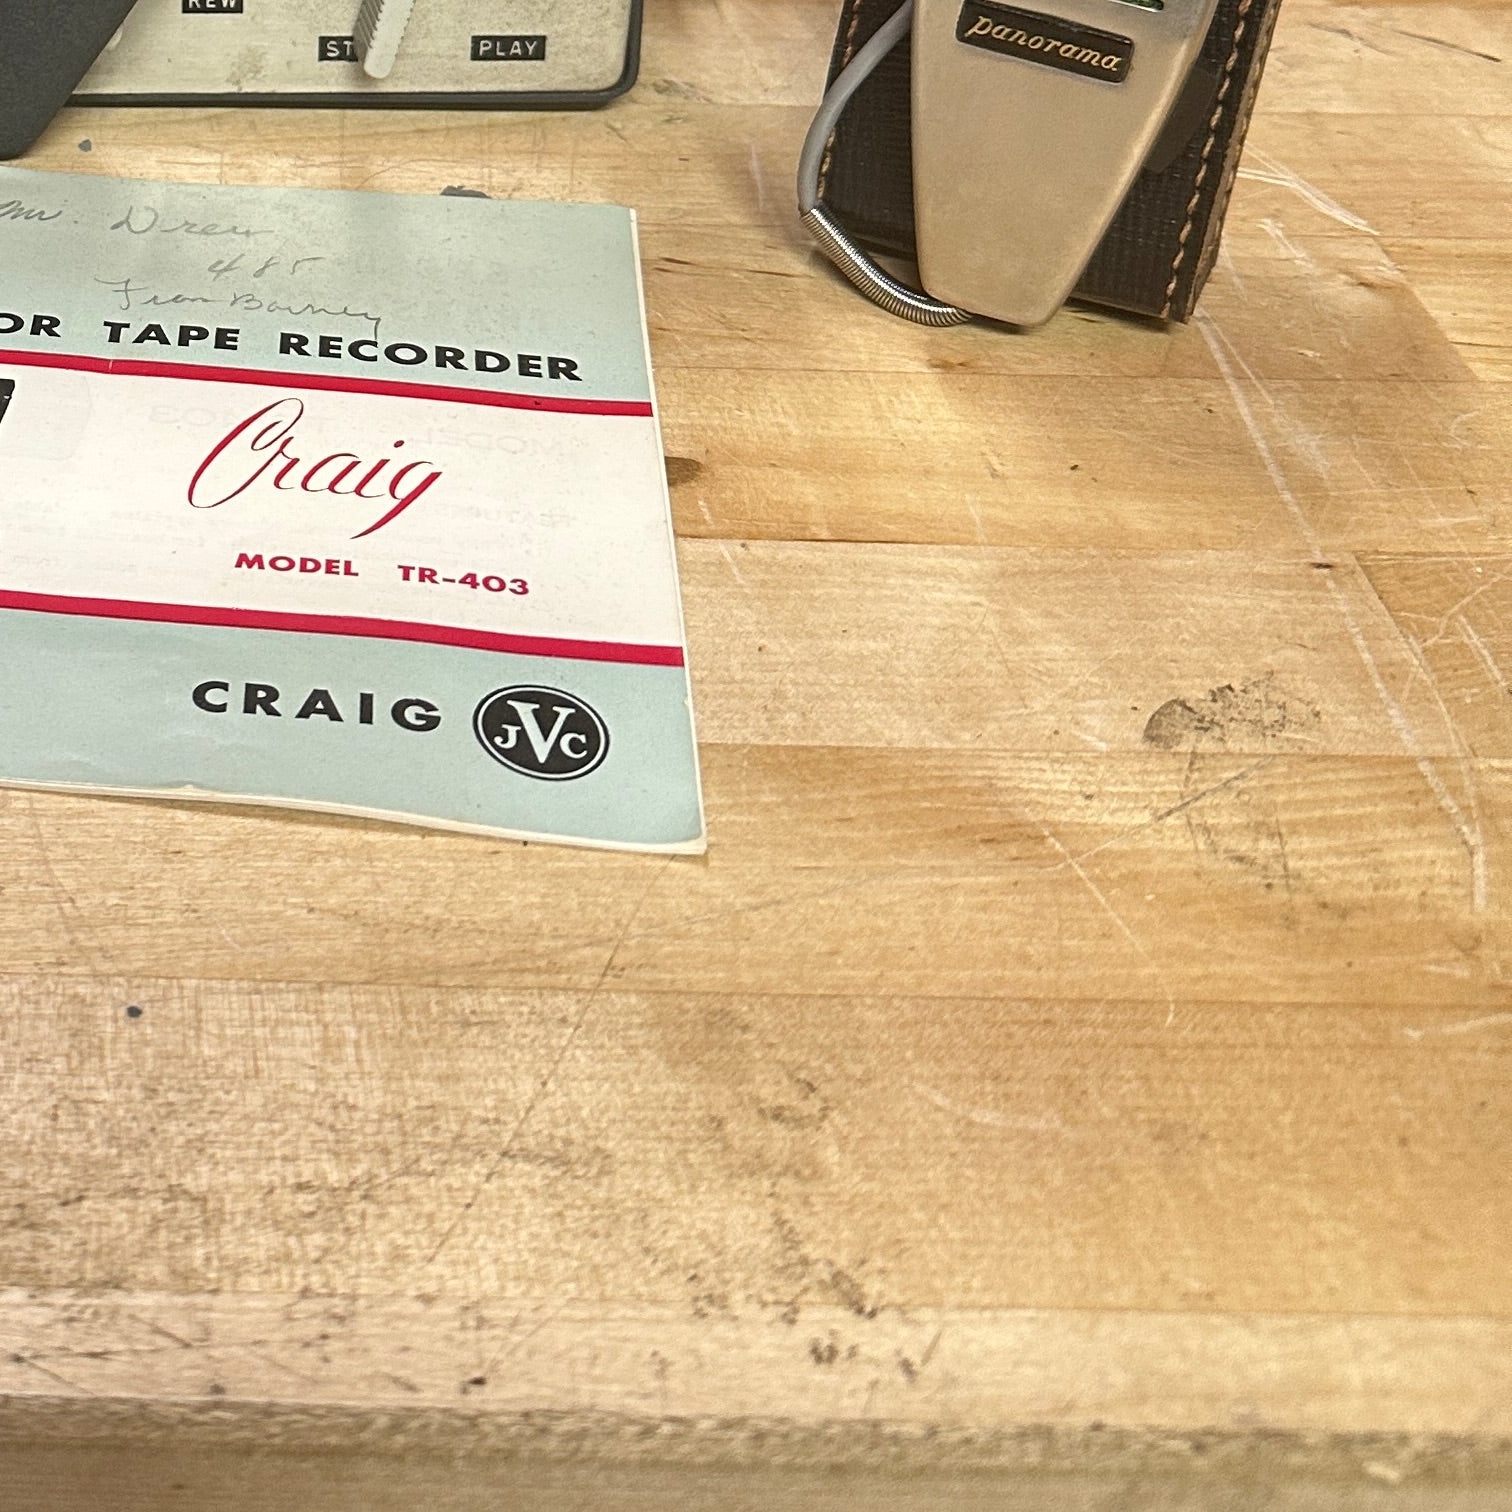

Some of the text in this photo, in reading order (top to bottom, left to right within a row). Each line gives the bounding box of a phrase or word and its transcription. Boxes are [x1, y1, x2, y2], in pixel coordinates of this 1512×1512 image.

[325, 40, 355, 58] ST
[477, 39, 537, 57] PLAY
[964, 15, 1122, 72] panorama
[103, 321, 241, 351] TAPE
[278, 332, 584, 382] RECORDER
[187, 397, 444, 540] Craig
[234, 552, 530, 596] MODEL TR-403
[191, 680, 443, 732] CRAIG
[493, 699, 588, 764] JVC
